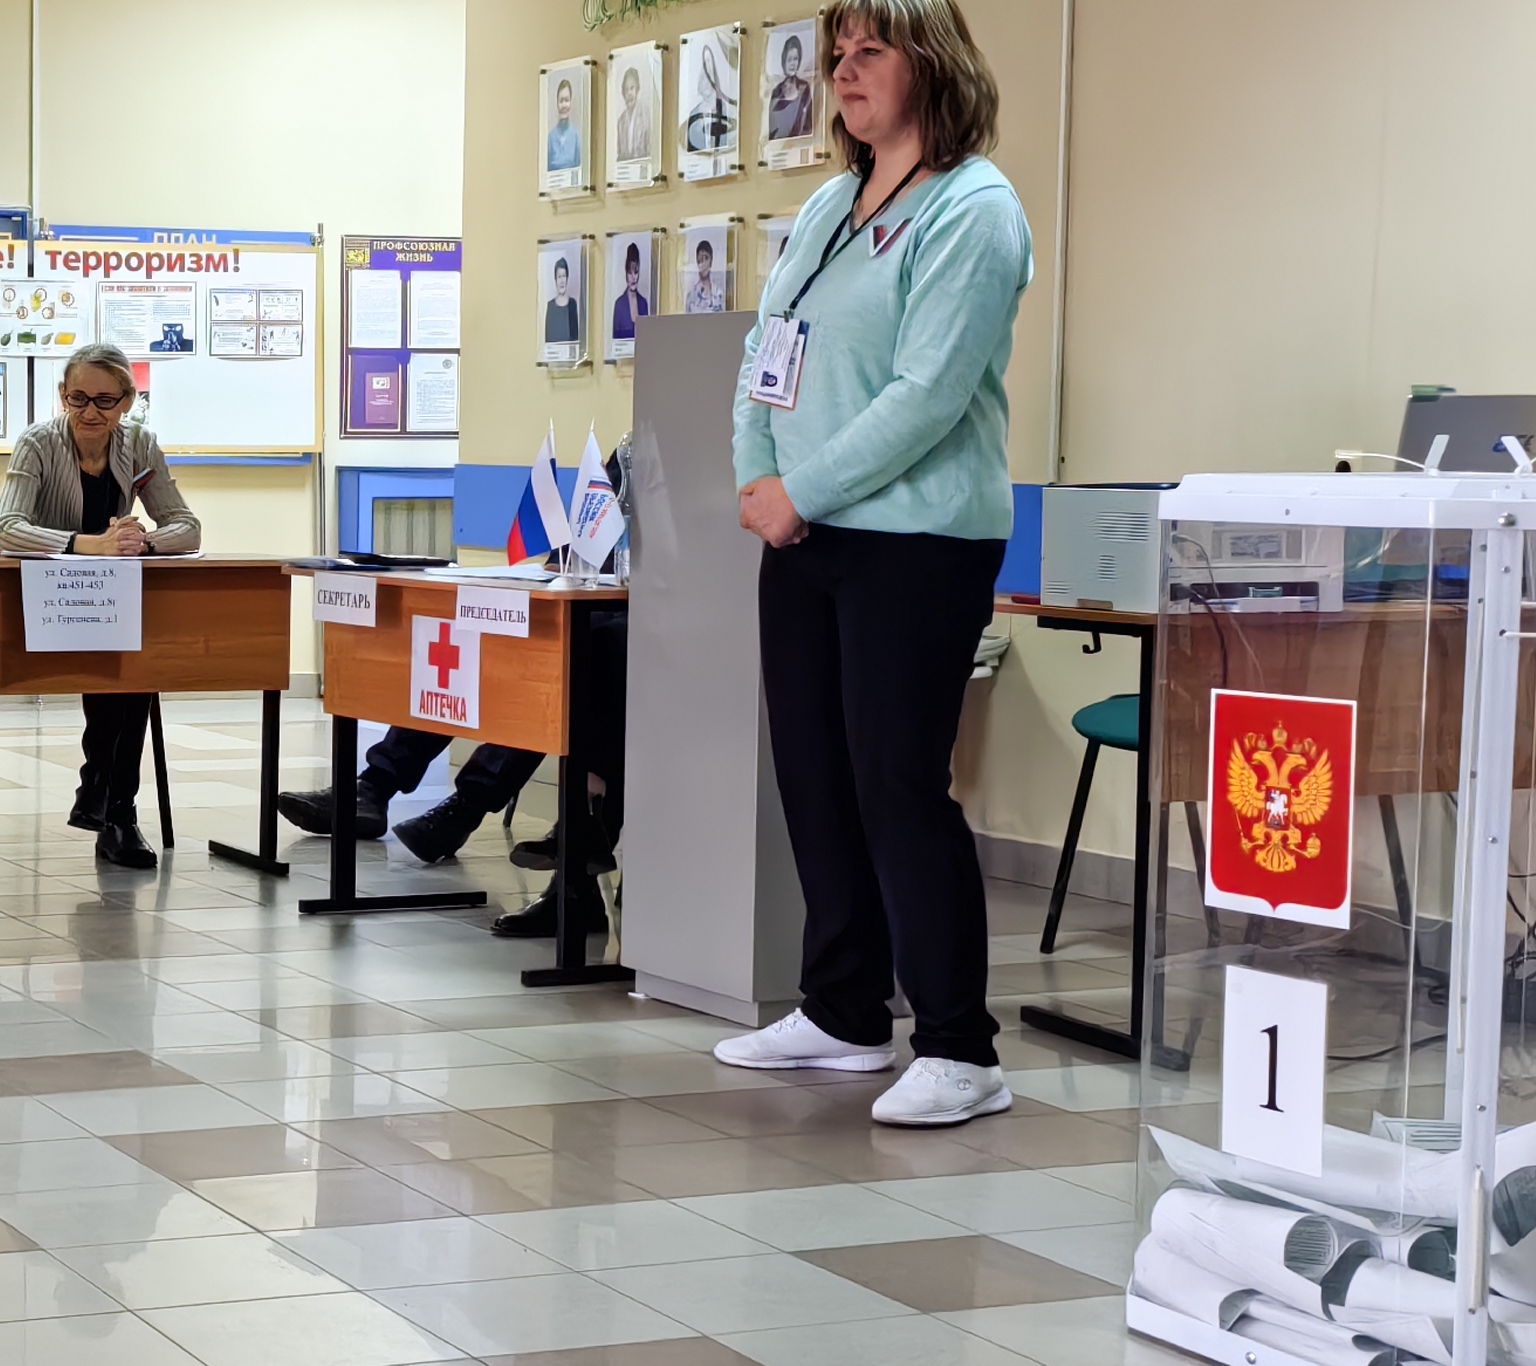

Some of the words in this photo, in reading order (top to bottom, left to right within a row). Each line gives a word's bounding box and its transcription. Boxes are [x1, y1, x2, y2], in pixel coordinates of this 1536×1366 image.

[373, 241, 456, 252] ПРОФСОЮЗНАЯ
[395, 252, 434, 263] ЖИЗНЬ
[45, 248, 240, 280] терроризм!
[317, 588, 371, 610] СЕКРЕТАРЬ
[459, 604, 527, 624] ПРЕДСЕДАТЕЛЬ
[419, 689, 468, 723] АПТЕЧКА
[1259, 1024, 1285, 1114] 1
